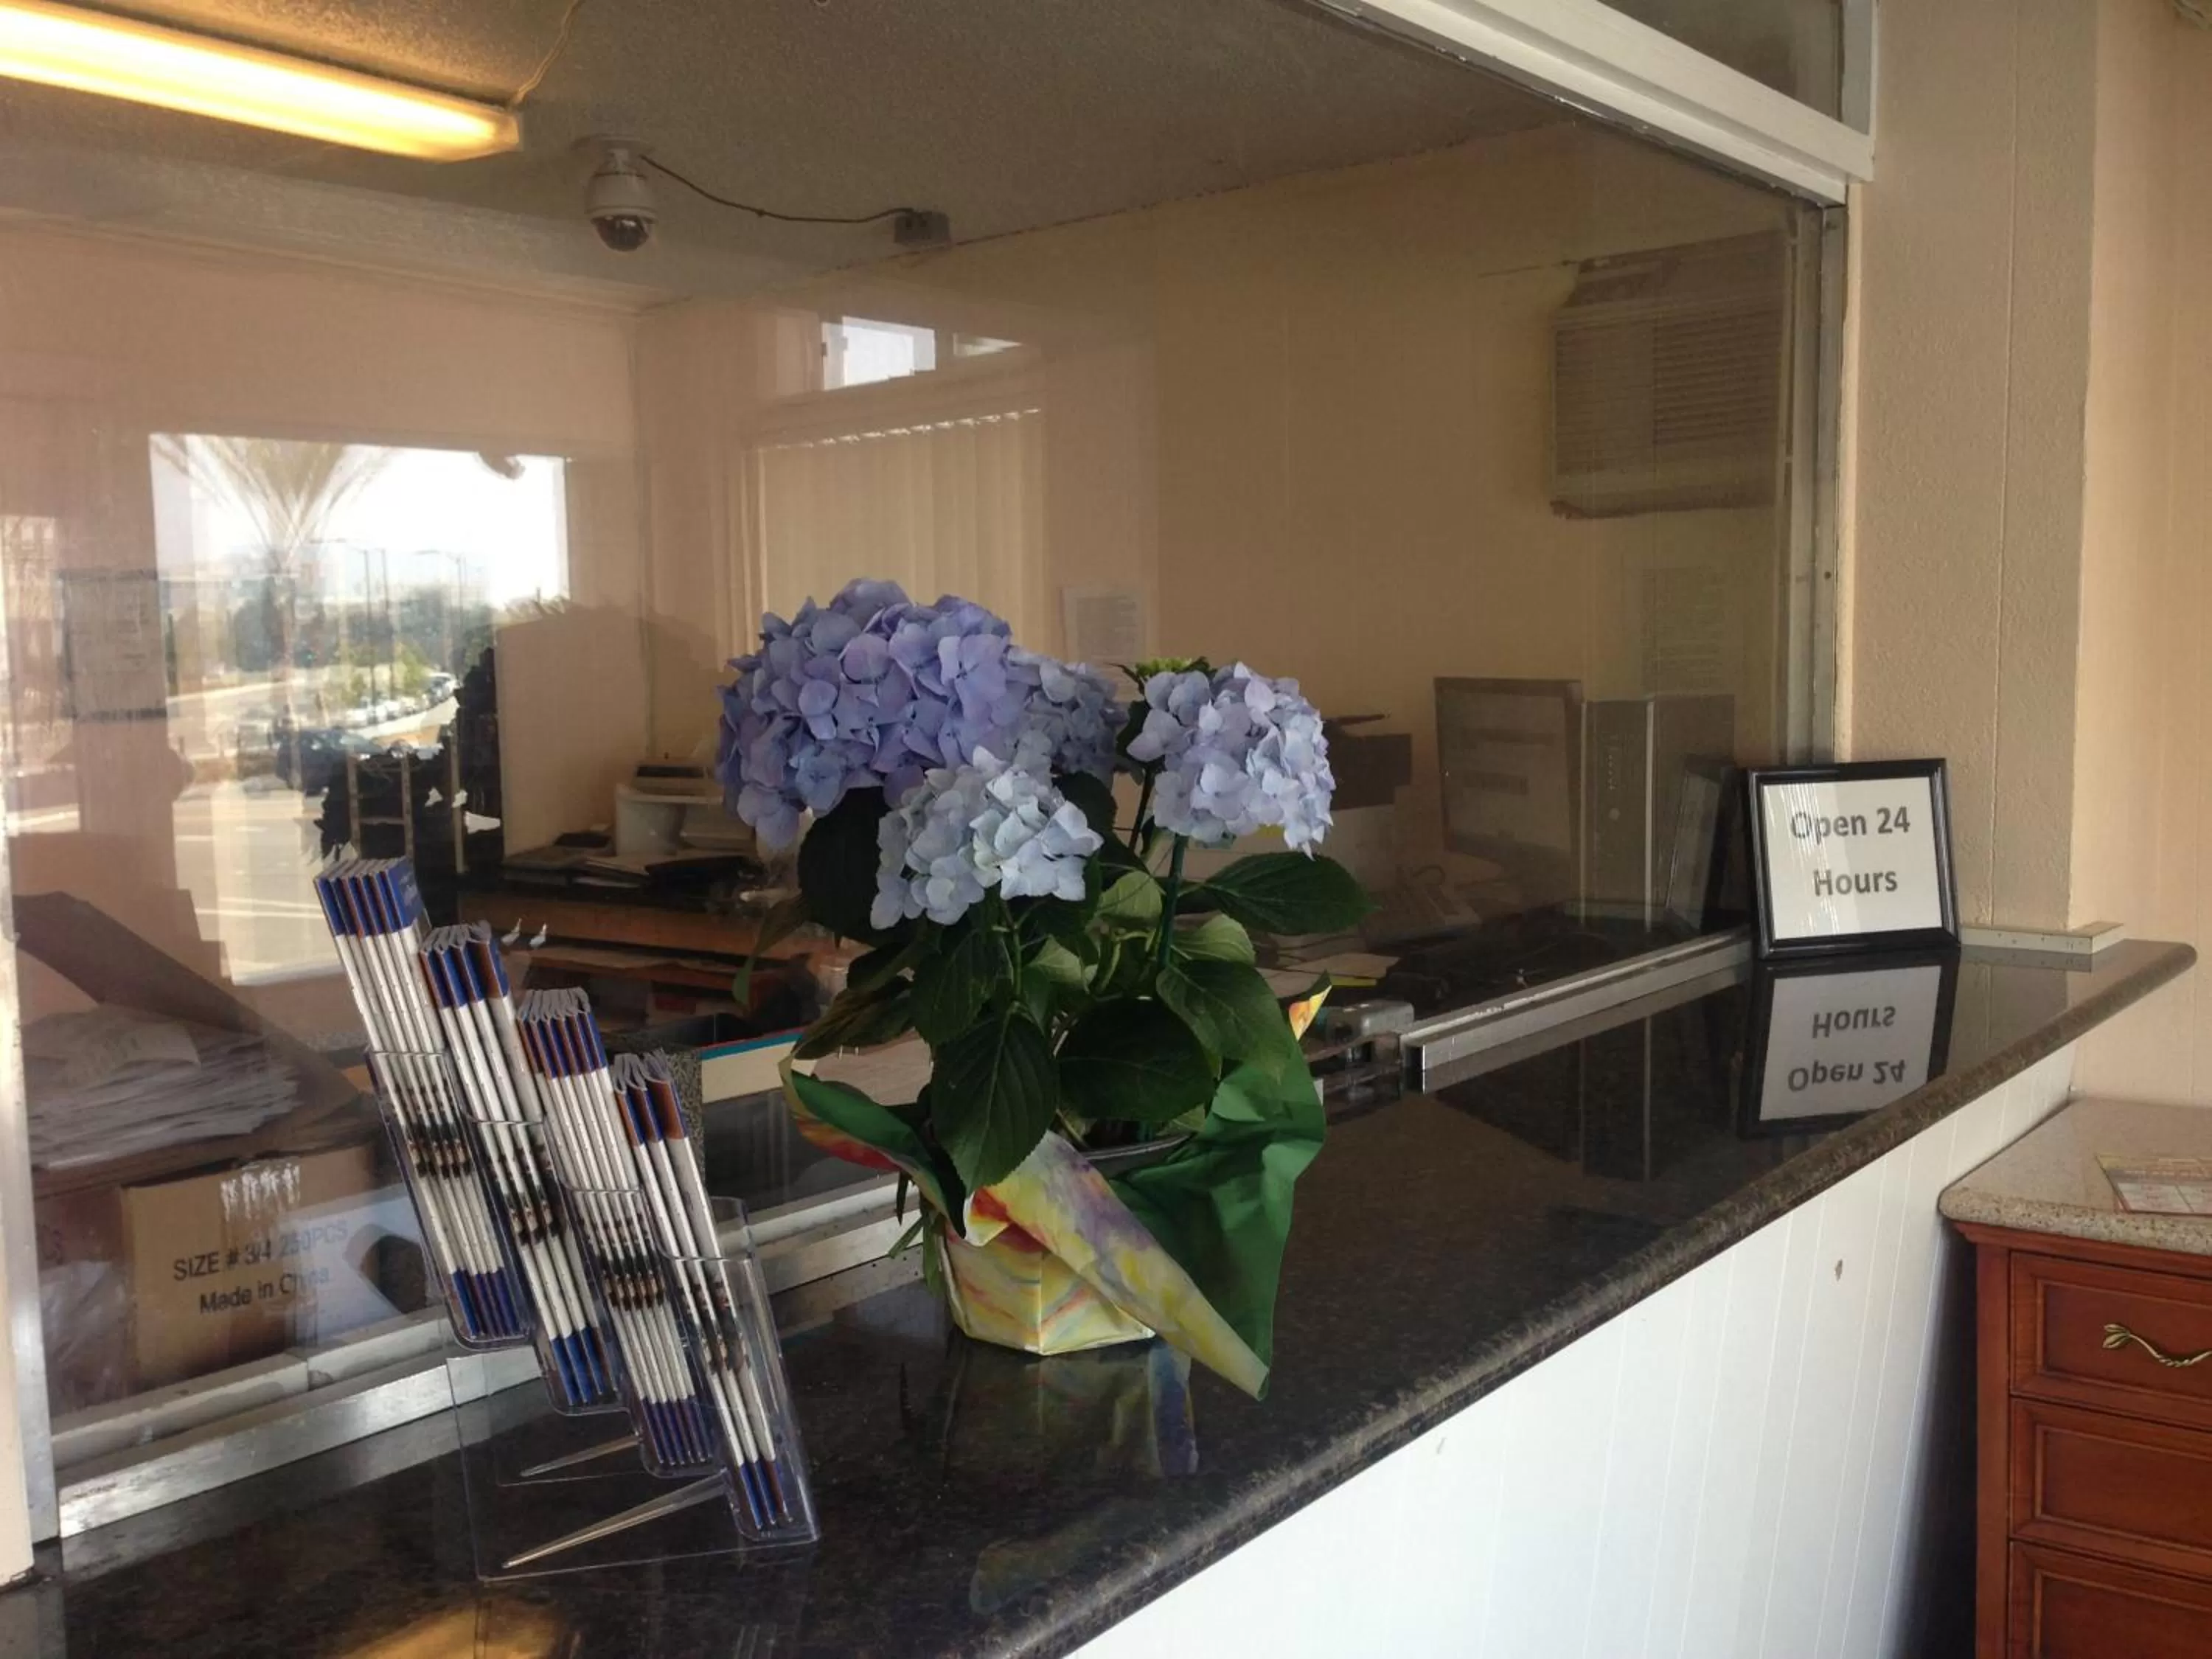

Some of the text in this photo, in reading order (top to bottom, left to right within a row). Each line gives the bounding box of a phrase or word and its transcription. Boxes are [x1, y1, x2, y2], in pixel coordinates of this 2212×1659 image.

[1790, 806, 1910, 844] Open 24
[1813, 869, 1898, 897] Hours
[173, 1251, 220, 1281] SIZE
[199, 1285, 253, 1313] Made
[257, 1279, 274, 1298] in
